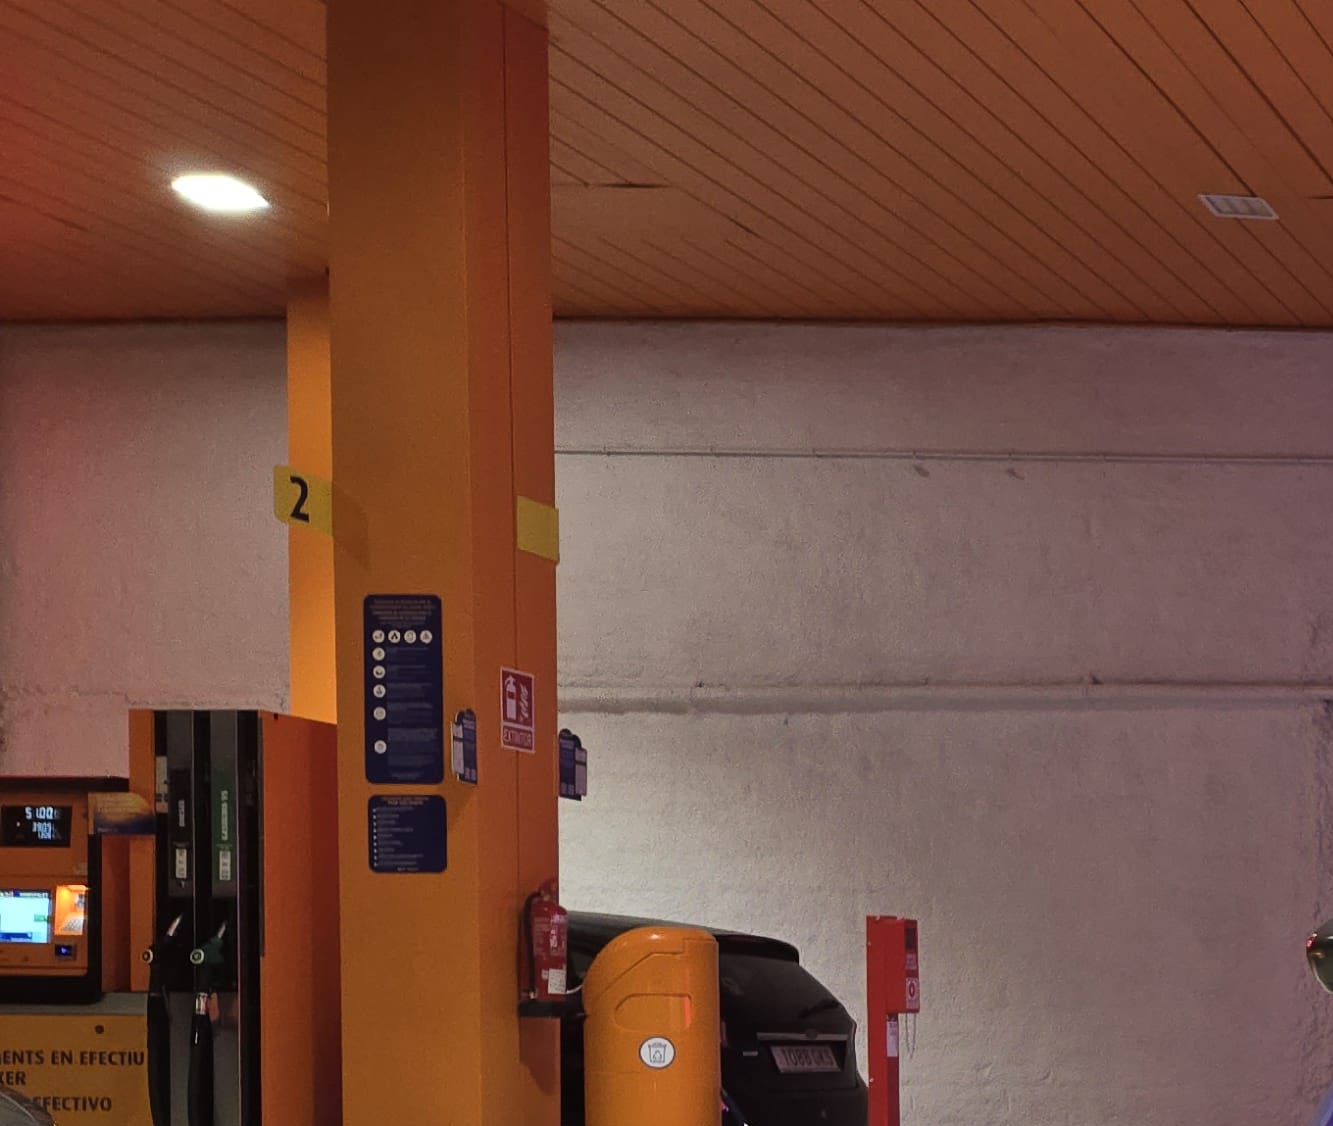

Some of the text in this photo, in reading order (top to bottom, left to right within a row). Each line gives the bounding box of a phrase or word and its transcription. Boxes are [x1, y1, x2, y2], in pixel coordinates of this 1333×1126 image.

[290, 475, 310, 523] 2
[0, 1050, 145, 1066] ENTS EN EFECTIU
